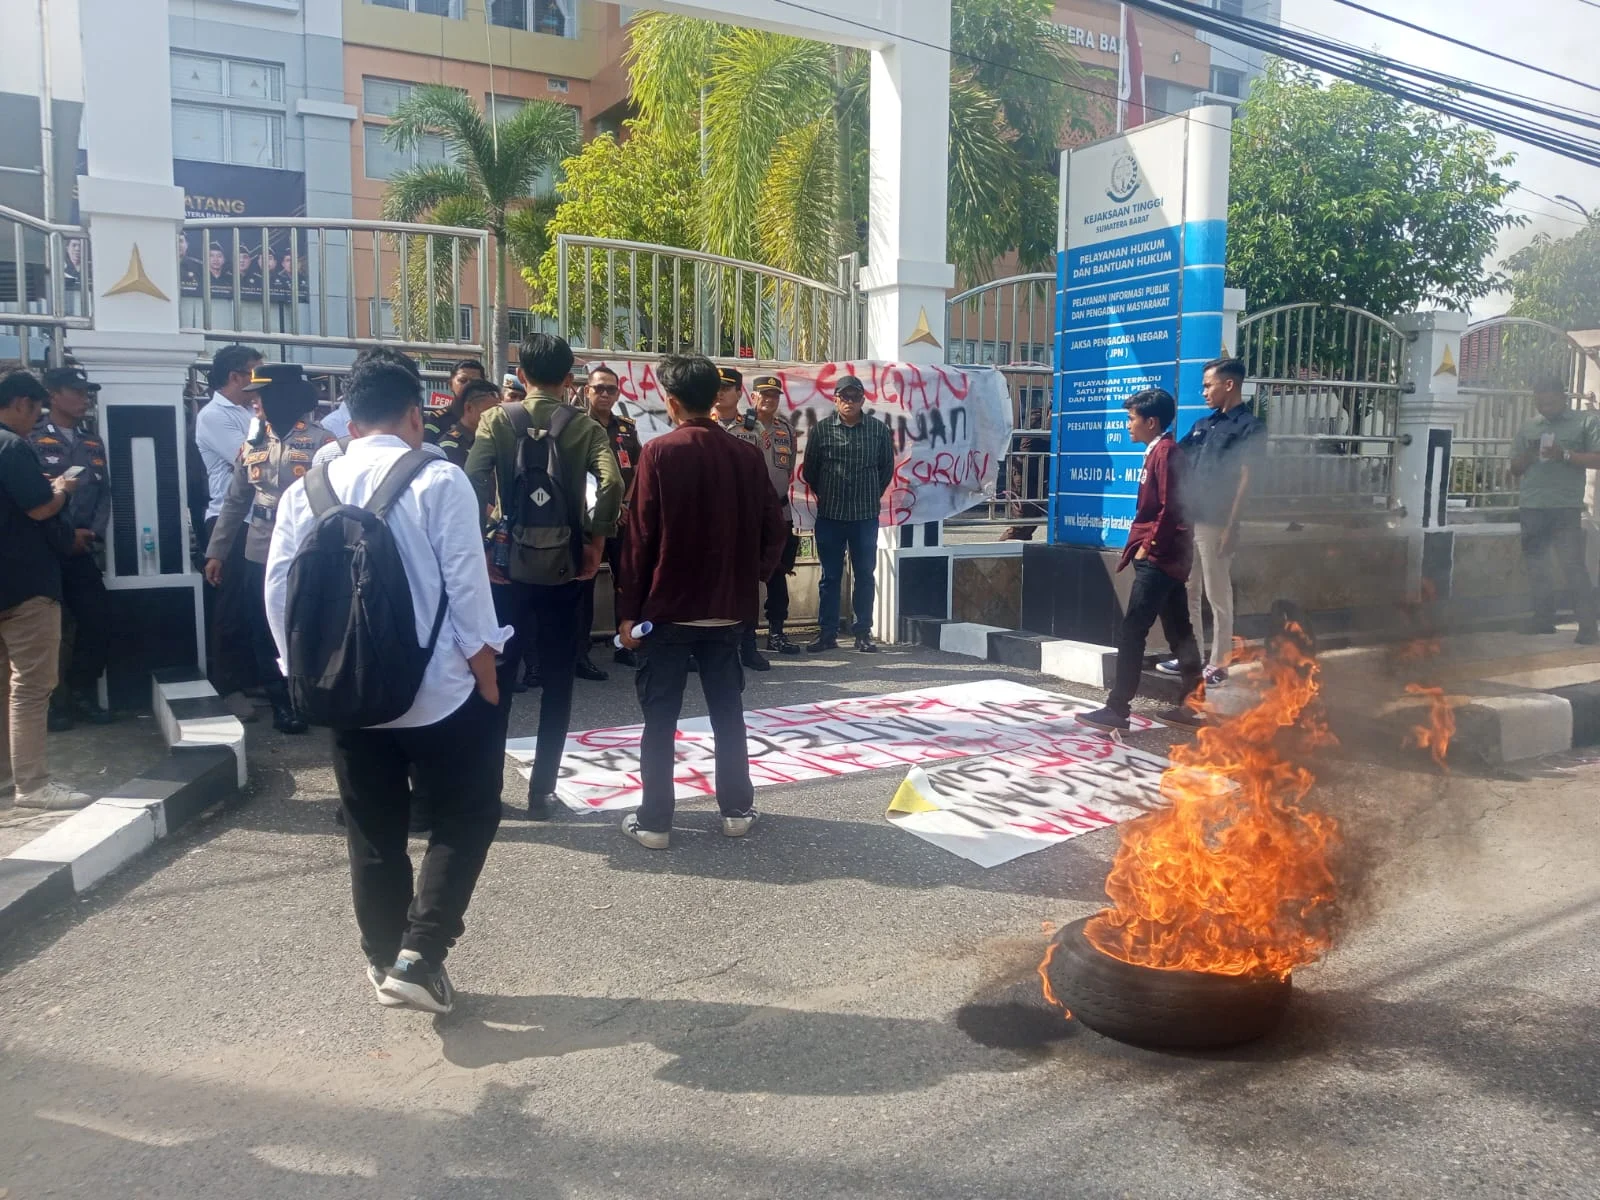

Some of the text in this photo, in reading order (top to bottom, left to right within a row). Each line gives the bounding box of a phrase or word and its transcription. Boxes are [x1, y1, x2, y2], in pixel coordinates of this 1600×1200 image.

[1100, 33, 1121, 53] BA
[1083, 197, 1164, 225] KEJAKSAAN TINGGI
[1096, 215, 1149, 233] SUMATERA BARAT
[1080, 238, 1165, 265] PELAYANAN HUKUM
[1073, 251, 1172, 279] DAN BANTUAN HUKUM
[1072, 283, 1170, 308] PELAYANAN INFORMASI PUBLIK
[1071, 297, 1170, 321] DAN PENGADUAN MASYARAKAT
[1070, 330, 1169, 350] JAKSA PENGACARA NEGARA
[1073, 375, 1162, 387] PELAYANAN TERPADU
[1076, 387, 1096, 395] SATU
[1098, 384, 1123, 393] PINTU
[435, 395, 453, 407] PER
[1087, 394, 1112, 402] DRIVE
[1113, 391, 1132, 401] THR
[1067, 421, 1102, 431] PERSATUAN
[1104, 420, 1125, 430] JAKSA
[1071, 467, 1102, 481] MASJID
[1125, 467, 1142, 482] MIZ
